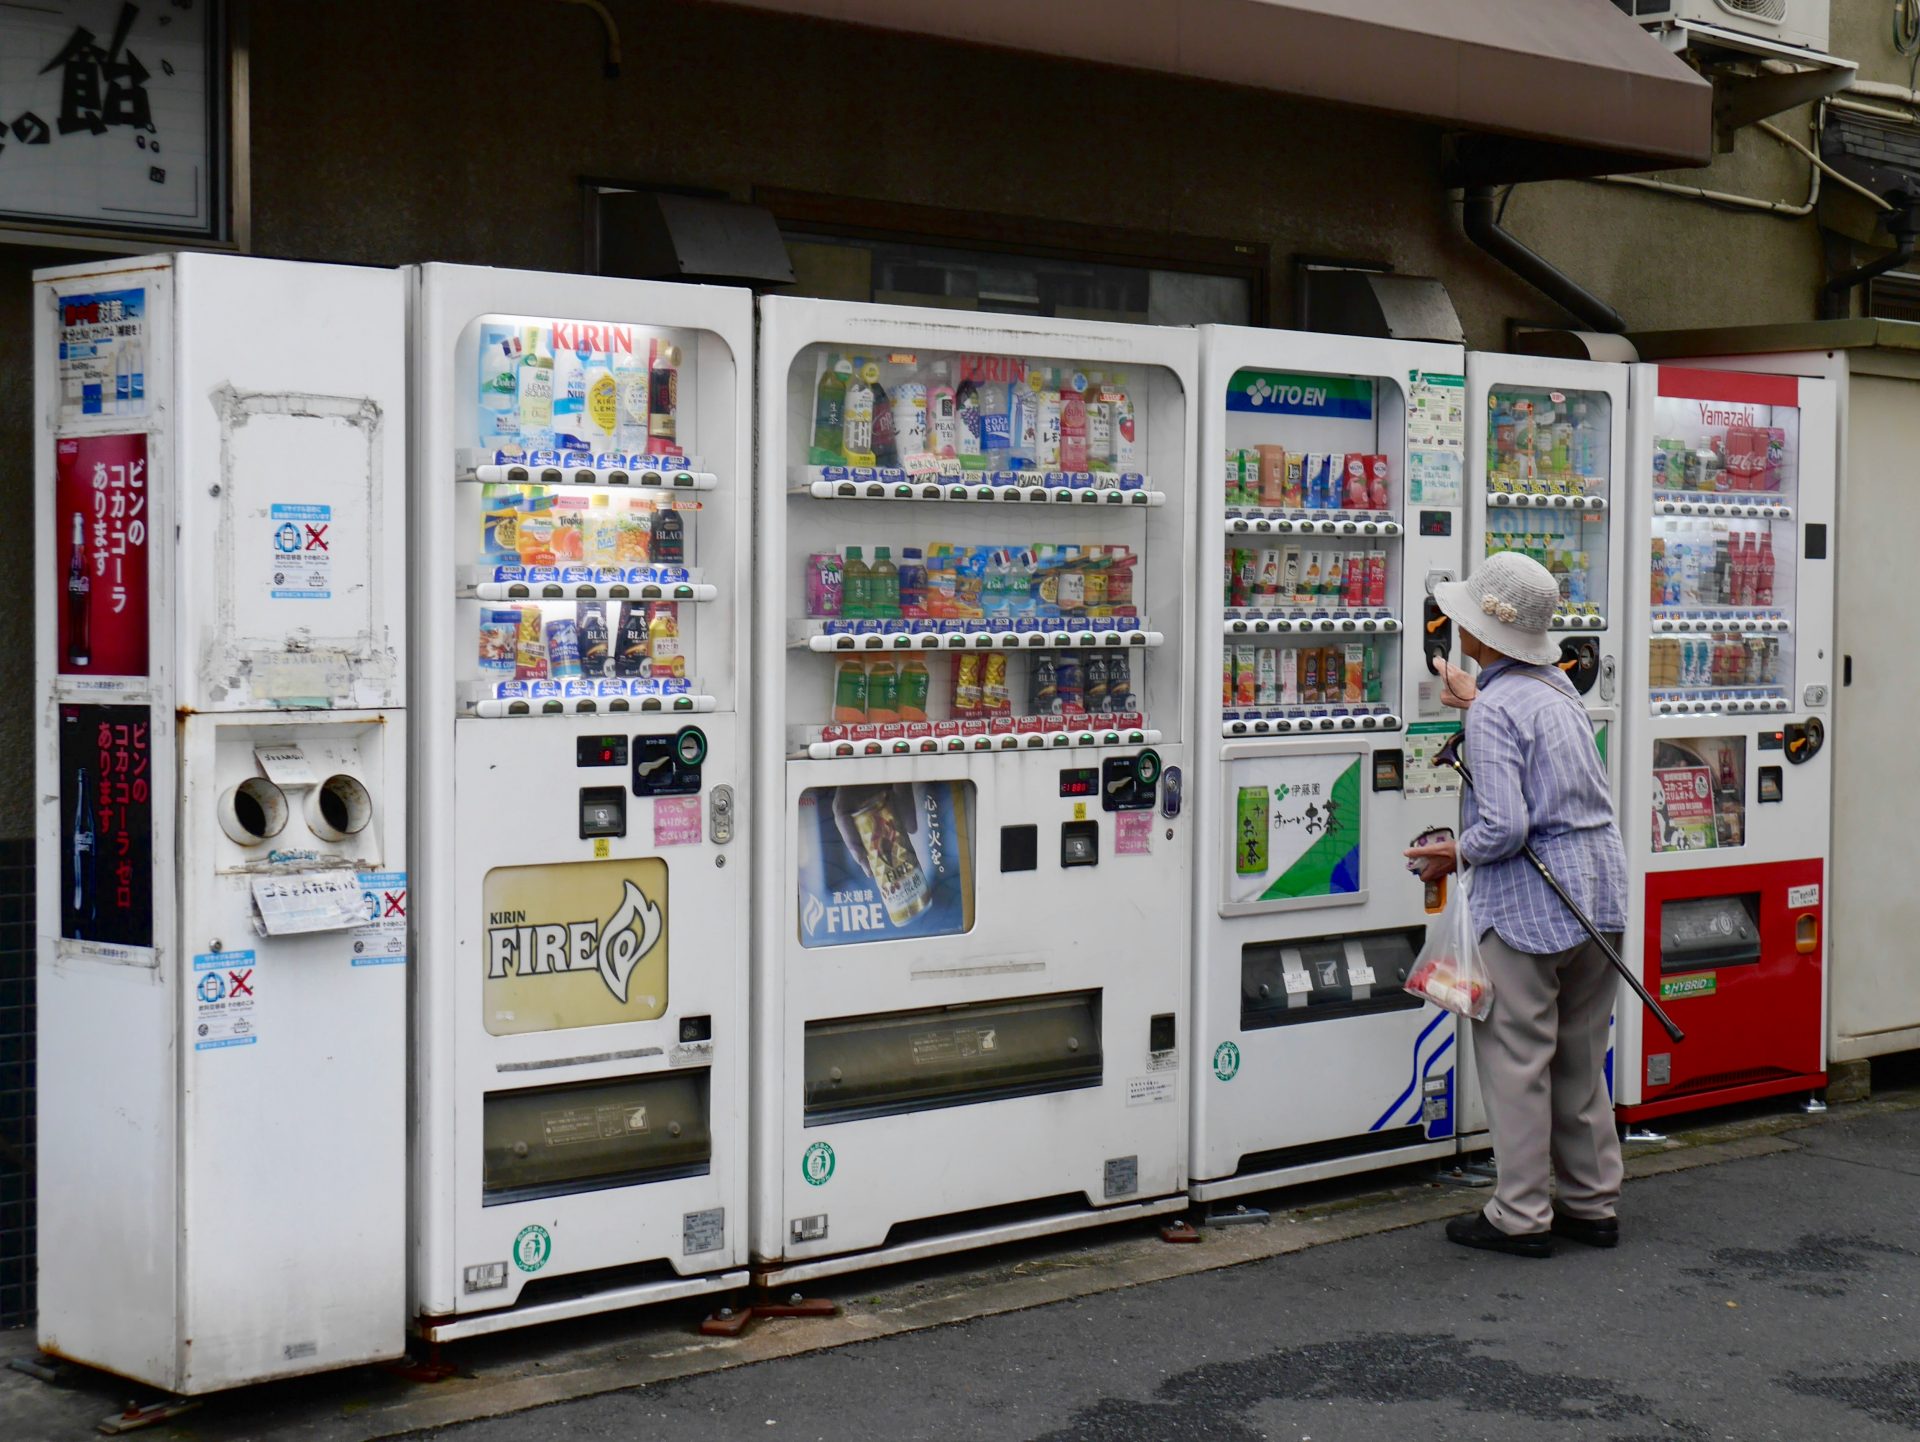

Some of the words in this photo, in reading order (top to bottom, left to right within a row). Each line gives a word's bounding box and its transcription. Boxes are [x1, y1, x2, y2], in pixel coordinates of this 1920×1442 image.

[552, 322, 632, 354] KIRIN
[959, 354, 1026, 383] KIRIN
[1270, 383, 1303, 405] ITO
[1303, 386, 1327, 407] EN
[1699, 402, 1755, 427] Yamazaki
[128, 459, 146, 548] ビンの
[92, 463, 110, 577] あります
[110, 464, 127, 615] コカ・コーラ
[132, 721, 149, 804] ビンの
[97, 721, 114, 835] あります
[1291, 783, 1321, 797] 伊藤園
[658, 817, 697, 827] ありがとう
[924, 795, 945, 874] 心に火を。
[886, 861, 915, 882] FIRE
[832, 889, 874, 904] 直火珈琲
[490, 910, 526, 925] KIRIN
[826, 903, 886, 933] FIRE
[488, 918, 599, 979] FIRE
[1671, 979, 1707, 993] HYBRID
